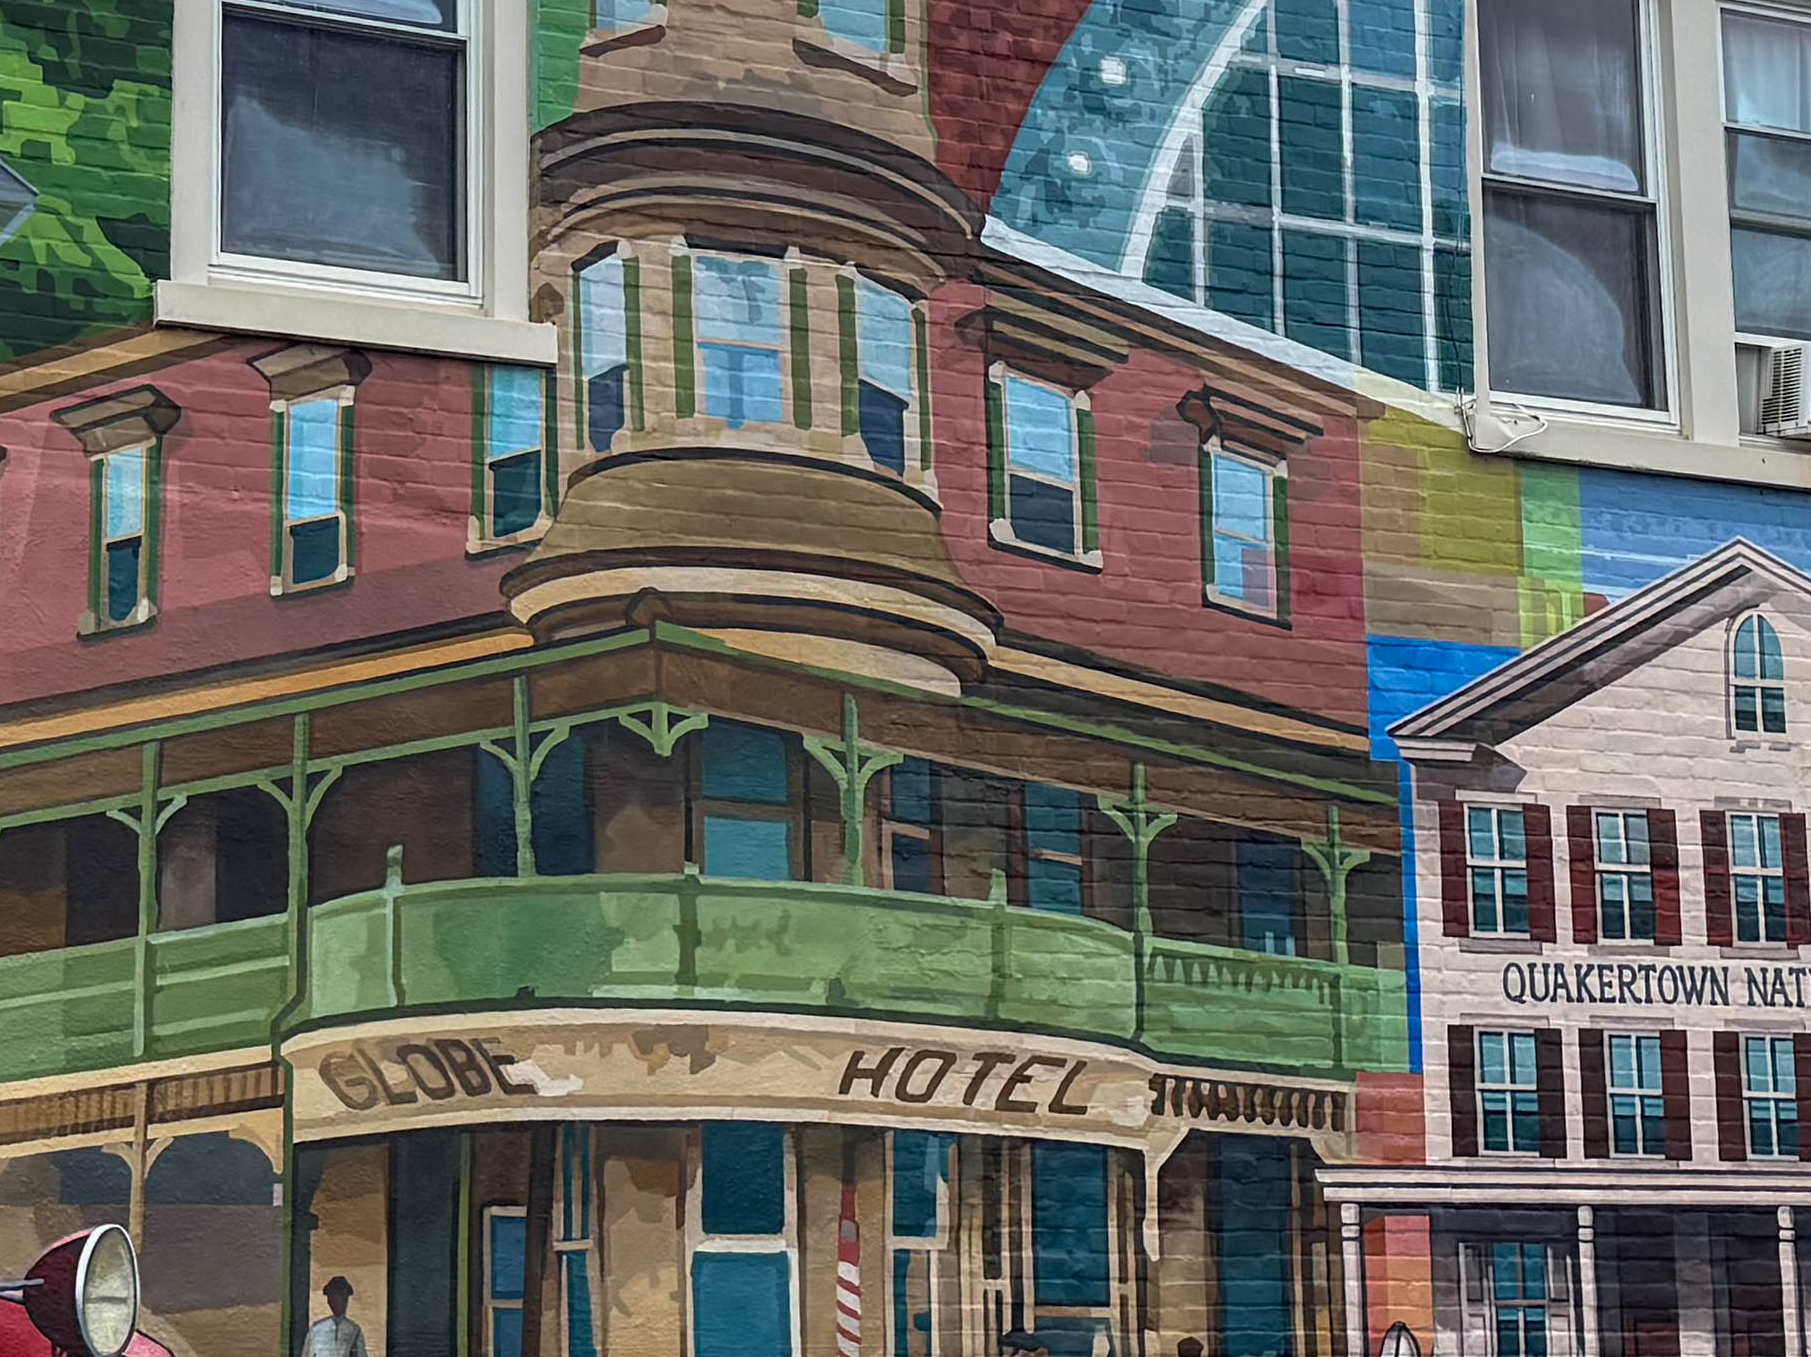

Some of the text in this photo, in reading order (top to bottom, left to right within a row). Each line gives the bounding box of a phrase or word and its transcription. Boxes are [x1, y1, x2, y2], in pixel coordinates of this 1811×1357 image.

[1502, 962, 1731, 1006] QUAKERTOWN
[317, 1036, 1095, 1117] GLOBE HOTEL
